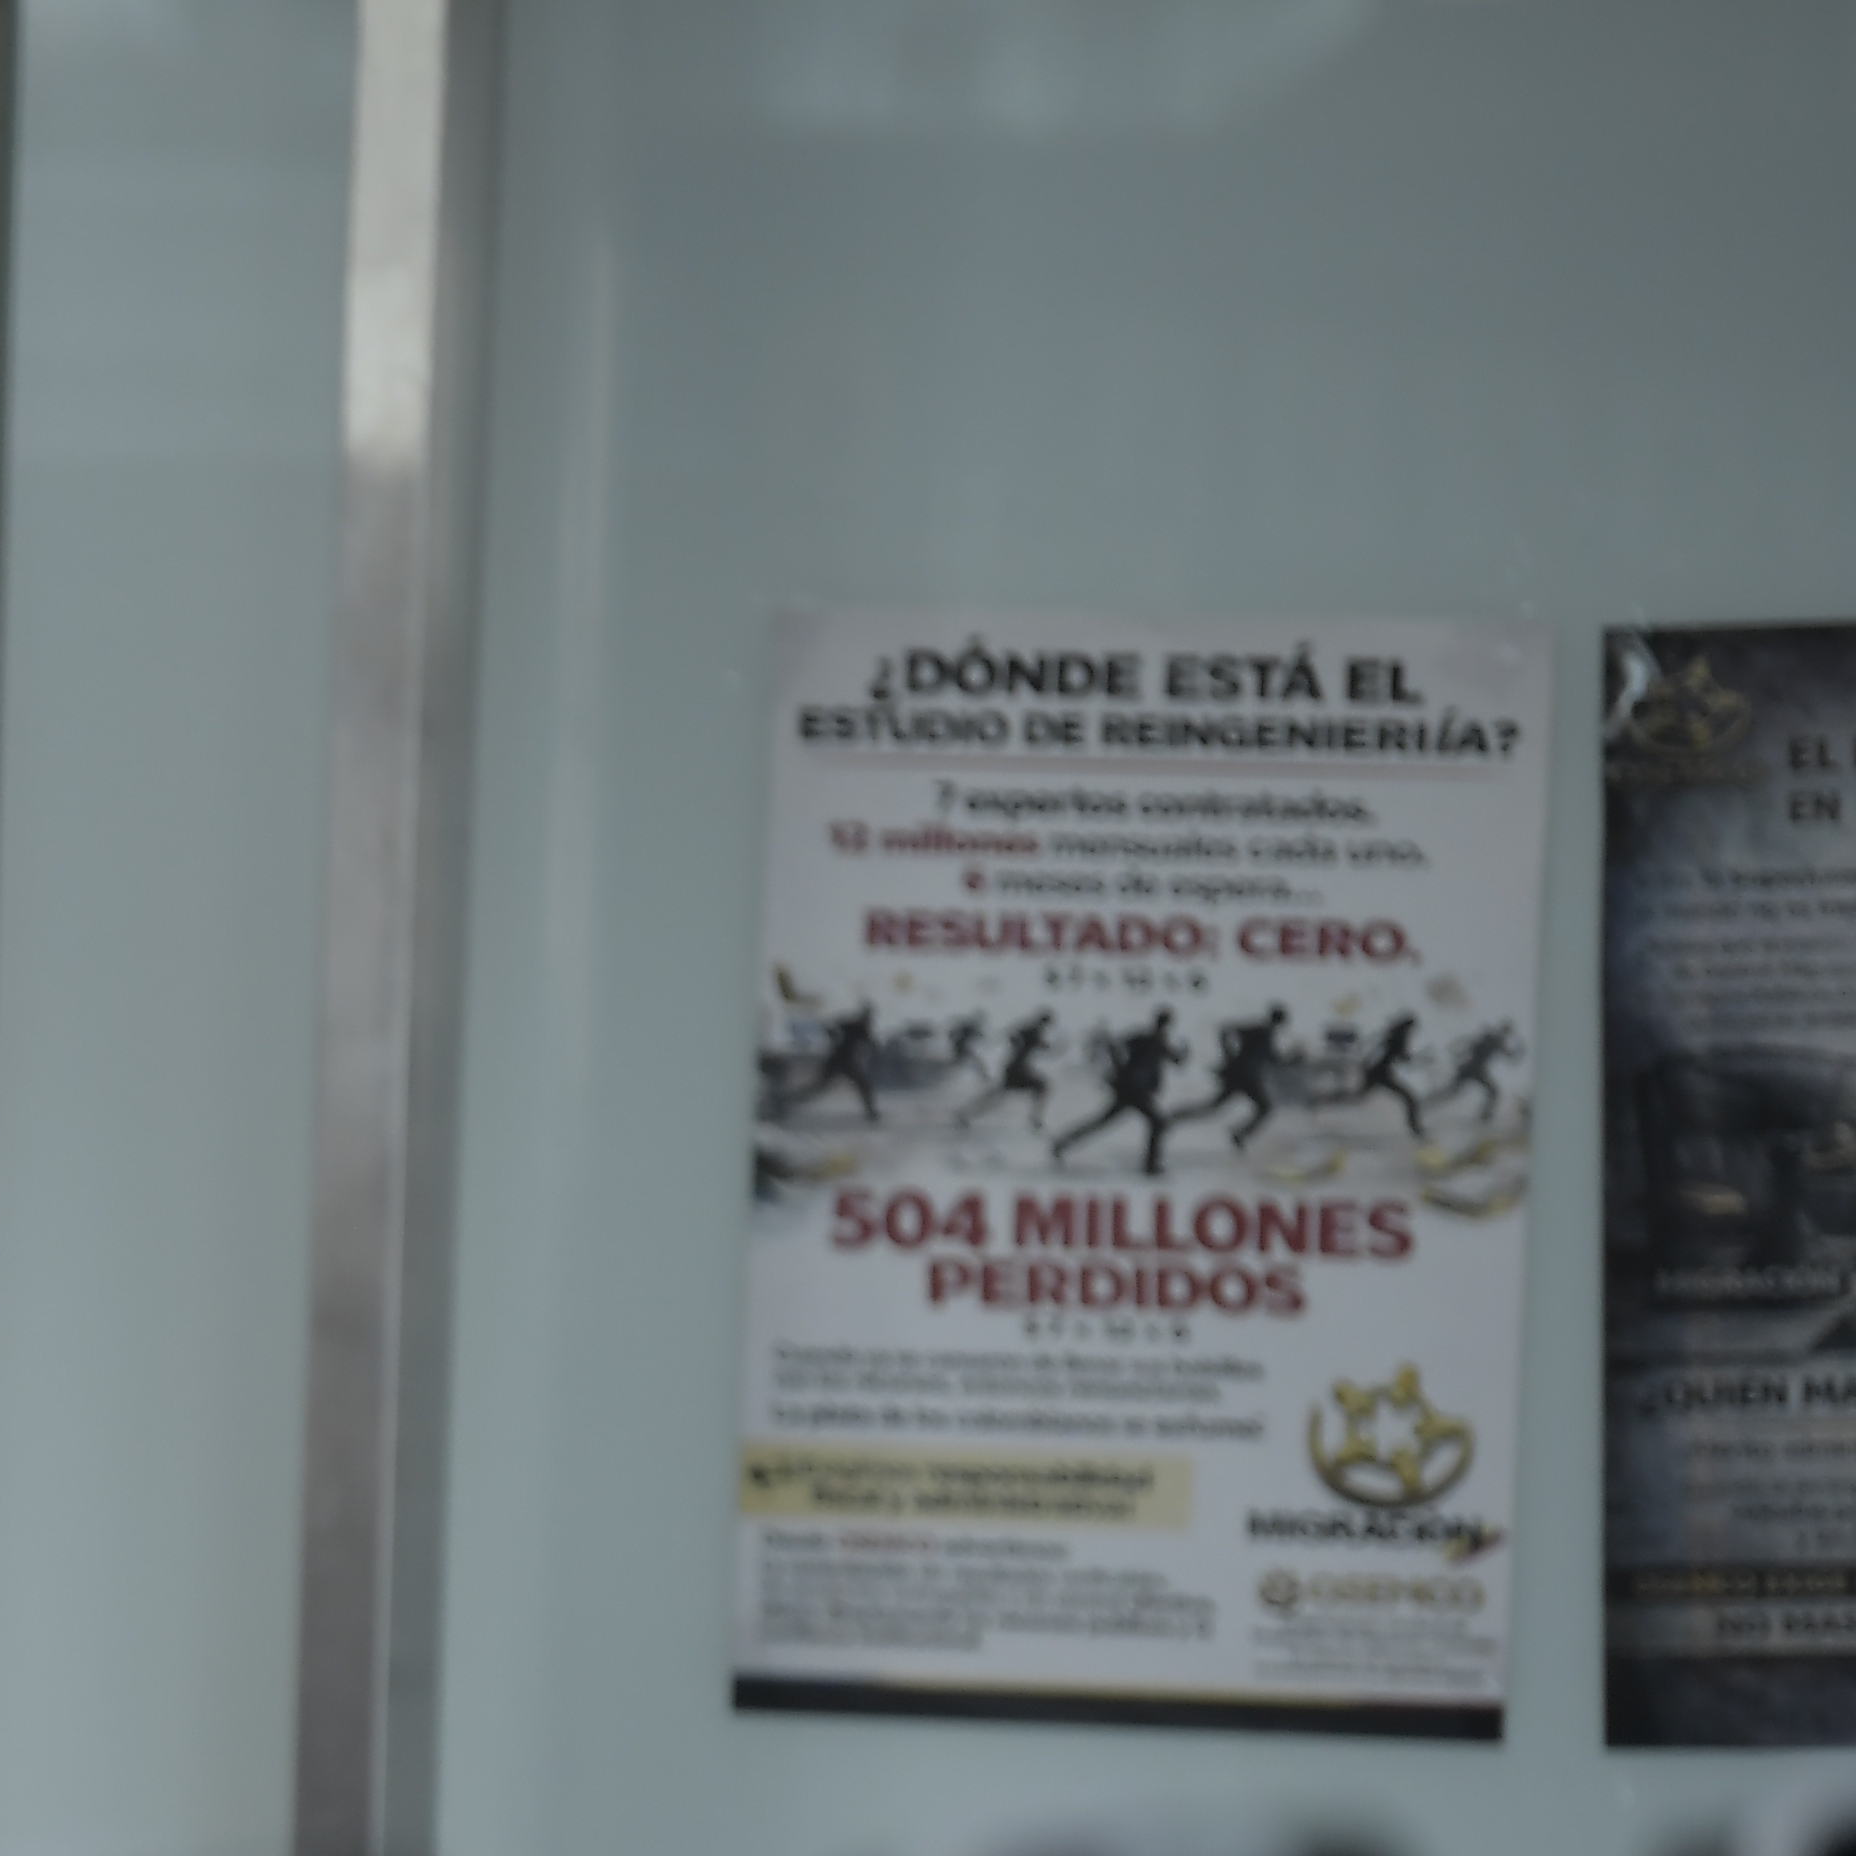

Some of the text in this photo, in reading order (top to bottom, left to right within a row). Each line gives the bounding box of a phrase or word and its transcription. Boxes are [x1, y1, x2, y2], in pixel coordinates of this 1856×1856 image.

[868, 637, 1423, 706] ¿DÓNDE ESTÁ EL
[799, 705, 1009, 746] ESTUDIO
[1022, 711, 1085, 747] DE
[833, 1192, 1414, 1258] 504 MILLONES
[926, 1256, 1306, 1315] PERDIDOS
